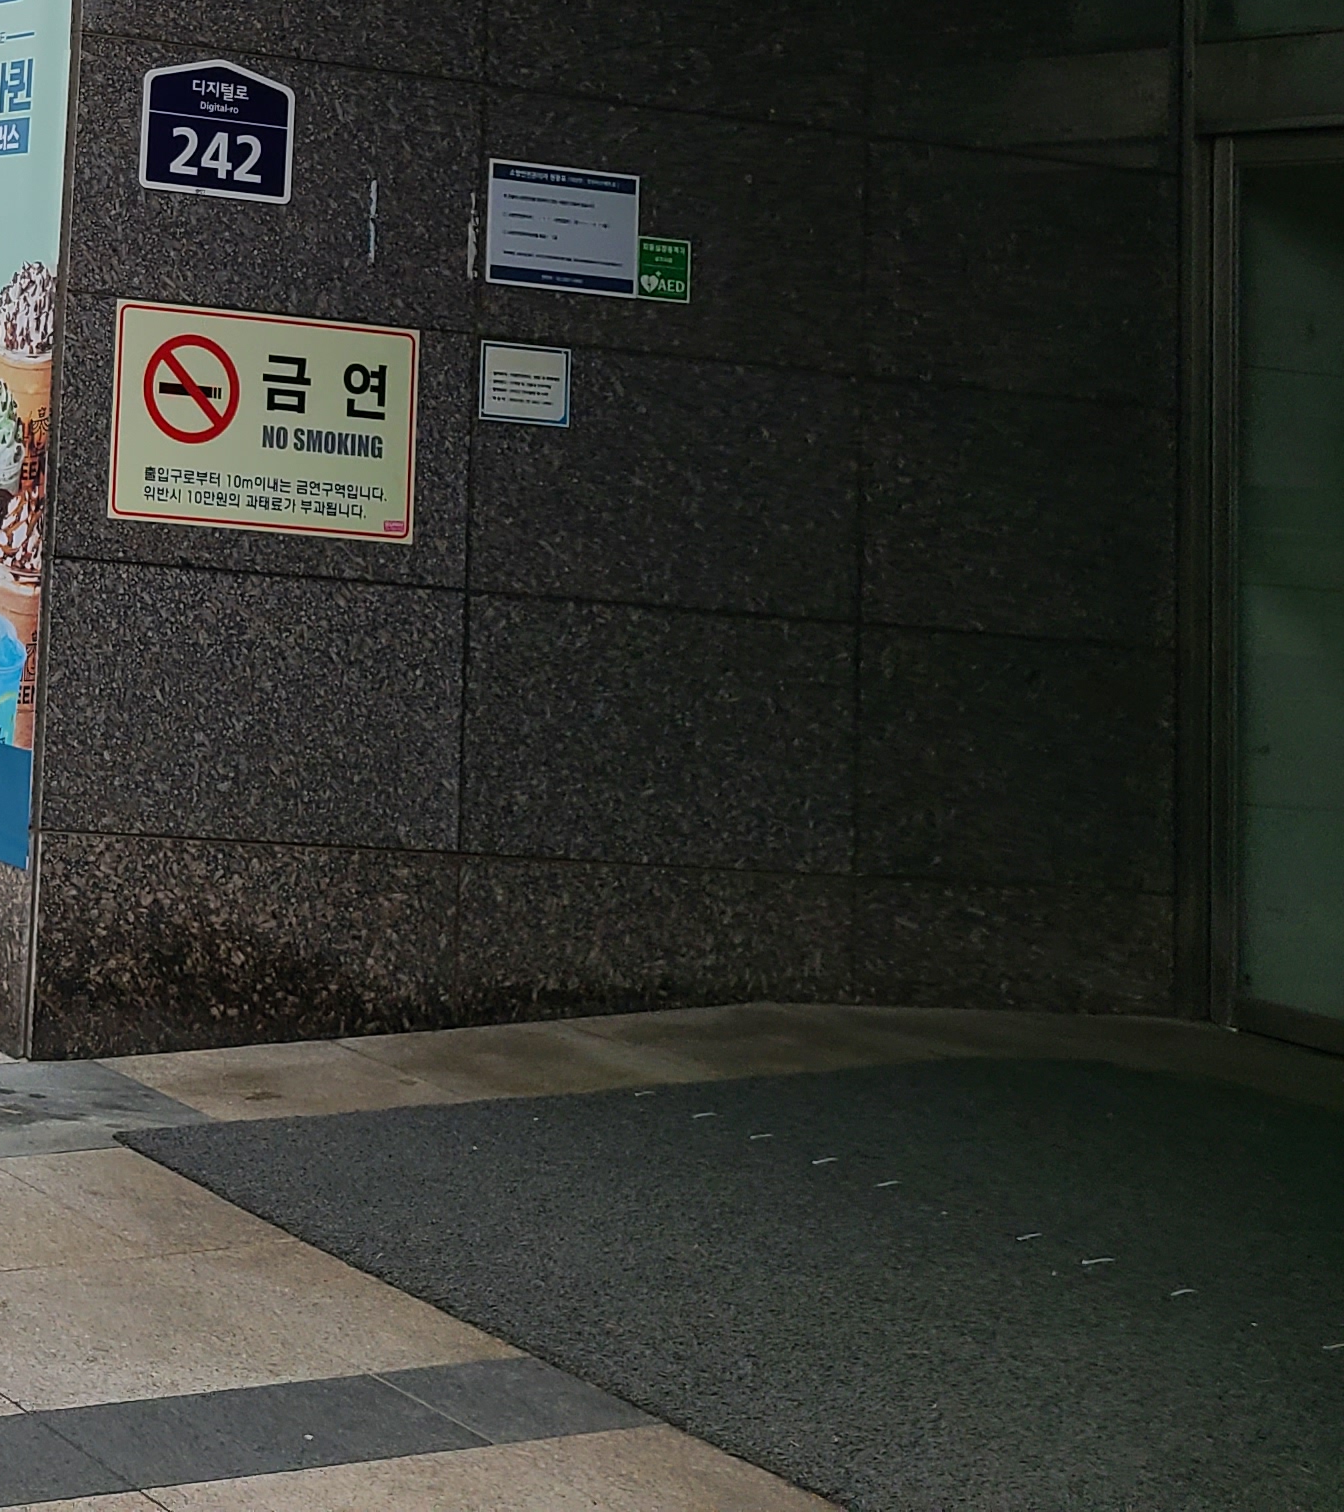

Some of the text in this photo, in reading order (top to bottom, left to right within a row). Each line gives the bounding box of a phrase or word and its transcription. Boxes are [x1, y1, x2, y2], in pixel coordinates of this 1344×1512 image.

[192, 79, 249, 102] 디지털로
[199, 100, 239, 114] Digital-ro
[169, 126, 262, 184] 242
[657, 278, 686, 293] AED
[262, 425, 384, 459] NO SMOKING
[144, 466, 388, 502] 출입구로부터 10m이내는 금연구역입니다.
[143, 485, 367, 519] 위반시 10만원의 과태료가 부과됩니다.
